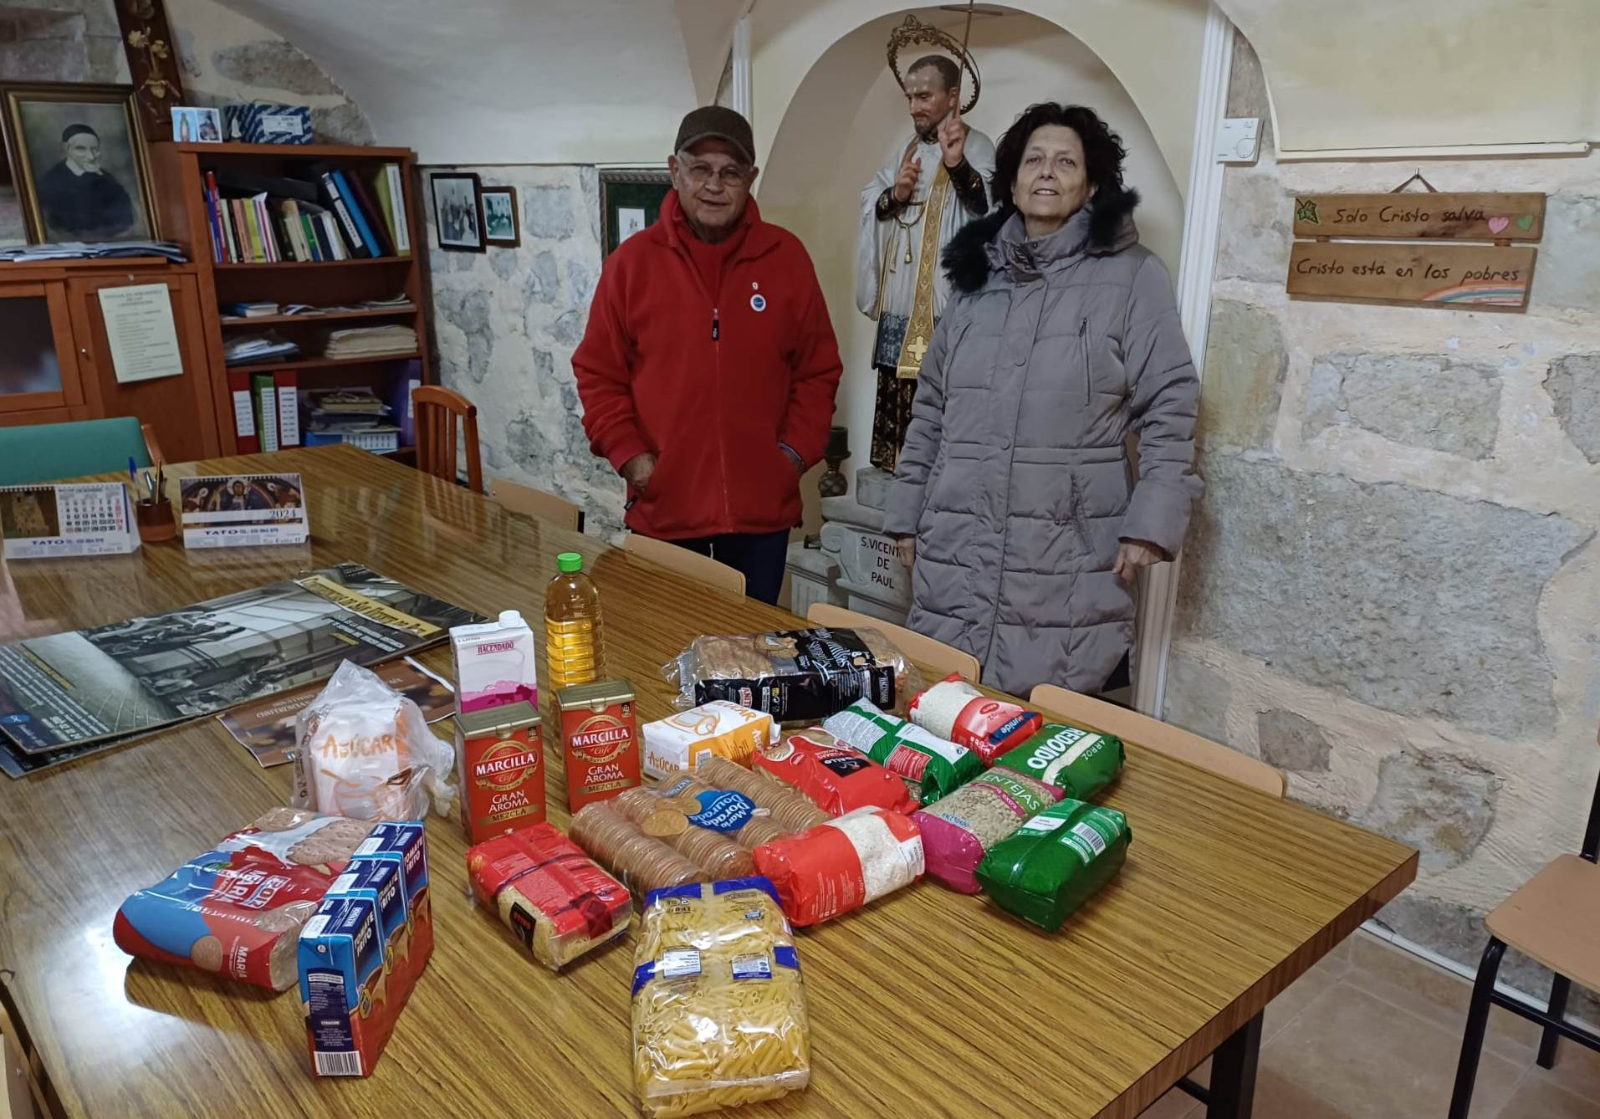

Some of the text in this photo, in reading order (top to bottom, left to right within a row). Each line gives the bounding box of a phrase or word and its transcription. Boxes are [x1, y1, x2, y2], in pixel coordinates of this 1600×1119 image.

[1379, 206, 1430, 222] Cristo
[1441, 206, 1488, 221] salva
[1296, 258, 1344, 275] Cristo
[1395, 266, 1413, 277] en
[1424, 264, 1450, 279] los
[1459, 265, 1519, 286] pobres
[269, 509, 297, 518] 2024
[876, 557, 889, 570] DE
[870, 572, 895, 589] PAUL
[476, 641, 515, 656] HACENDADO
[572, 729, 629, 747] MARCILLA
[1027, 728, 1087, 770] REDONDO
[1081, 739, 1106, 760] ARROZ
[475, 752, 535, 776] MARCILLA
[587, 763, 619, 775] GRAN
[584, 771, 624, 784] AROMA
[588, 782, 622, 793] MEZCLA
[492, 789, 525, 804] GRAN
[488, 797, 530, 814] AROMA
[689, 794, 743, 821] Dourada
[492, 808, 527, 822] MEZCLA
[701, 802, 750, 827] Dorada
[354, 911, 375, 947] TOMATE
[356, 927, 372, 958] FRITO
